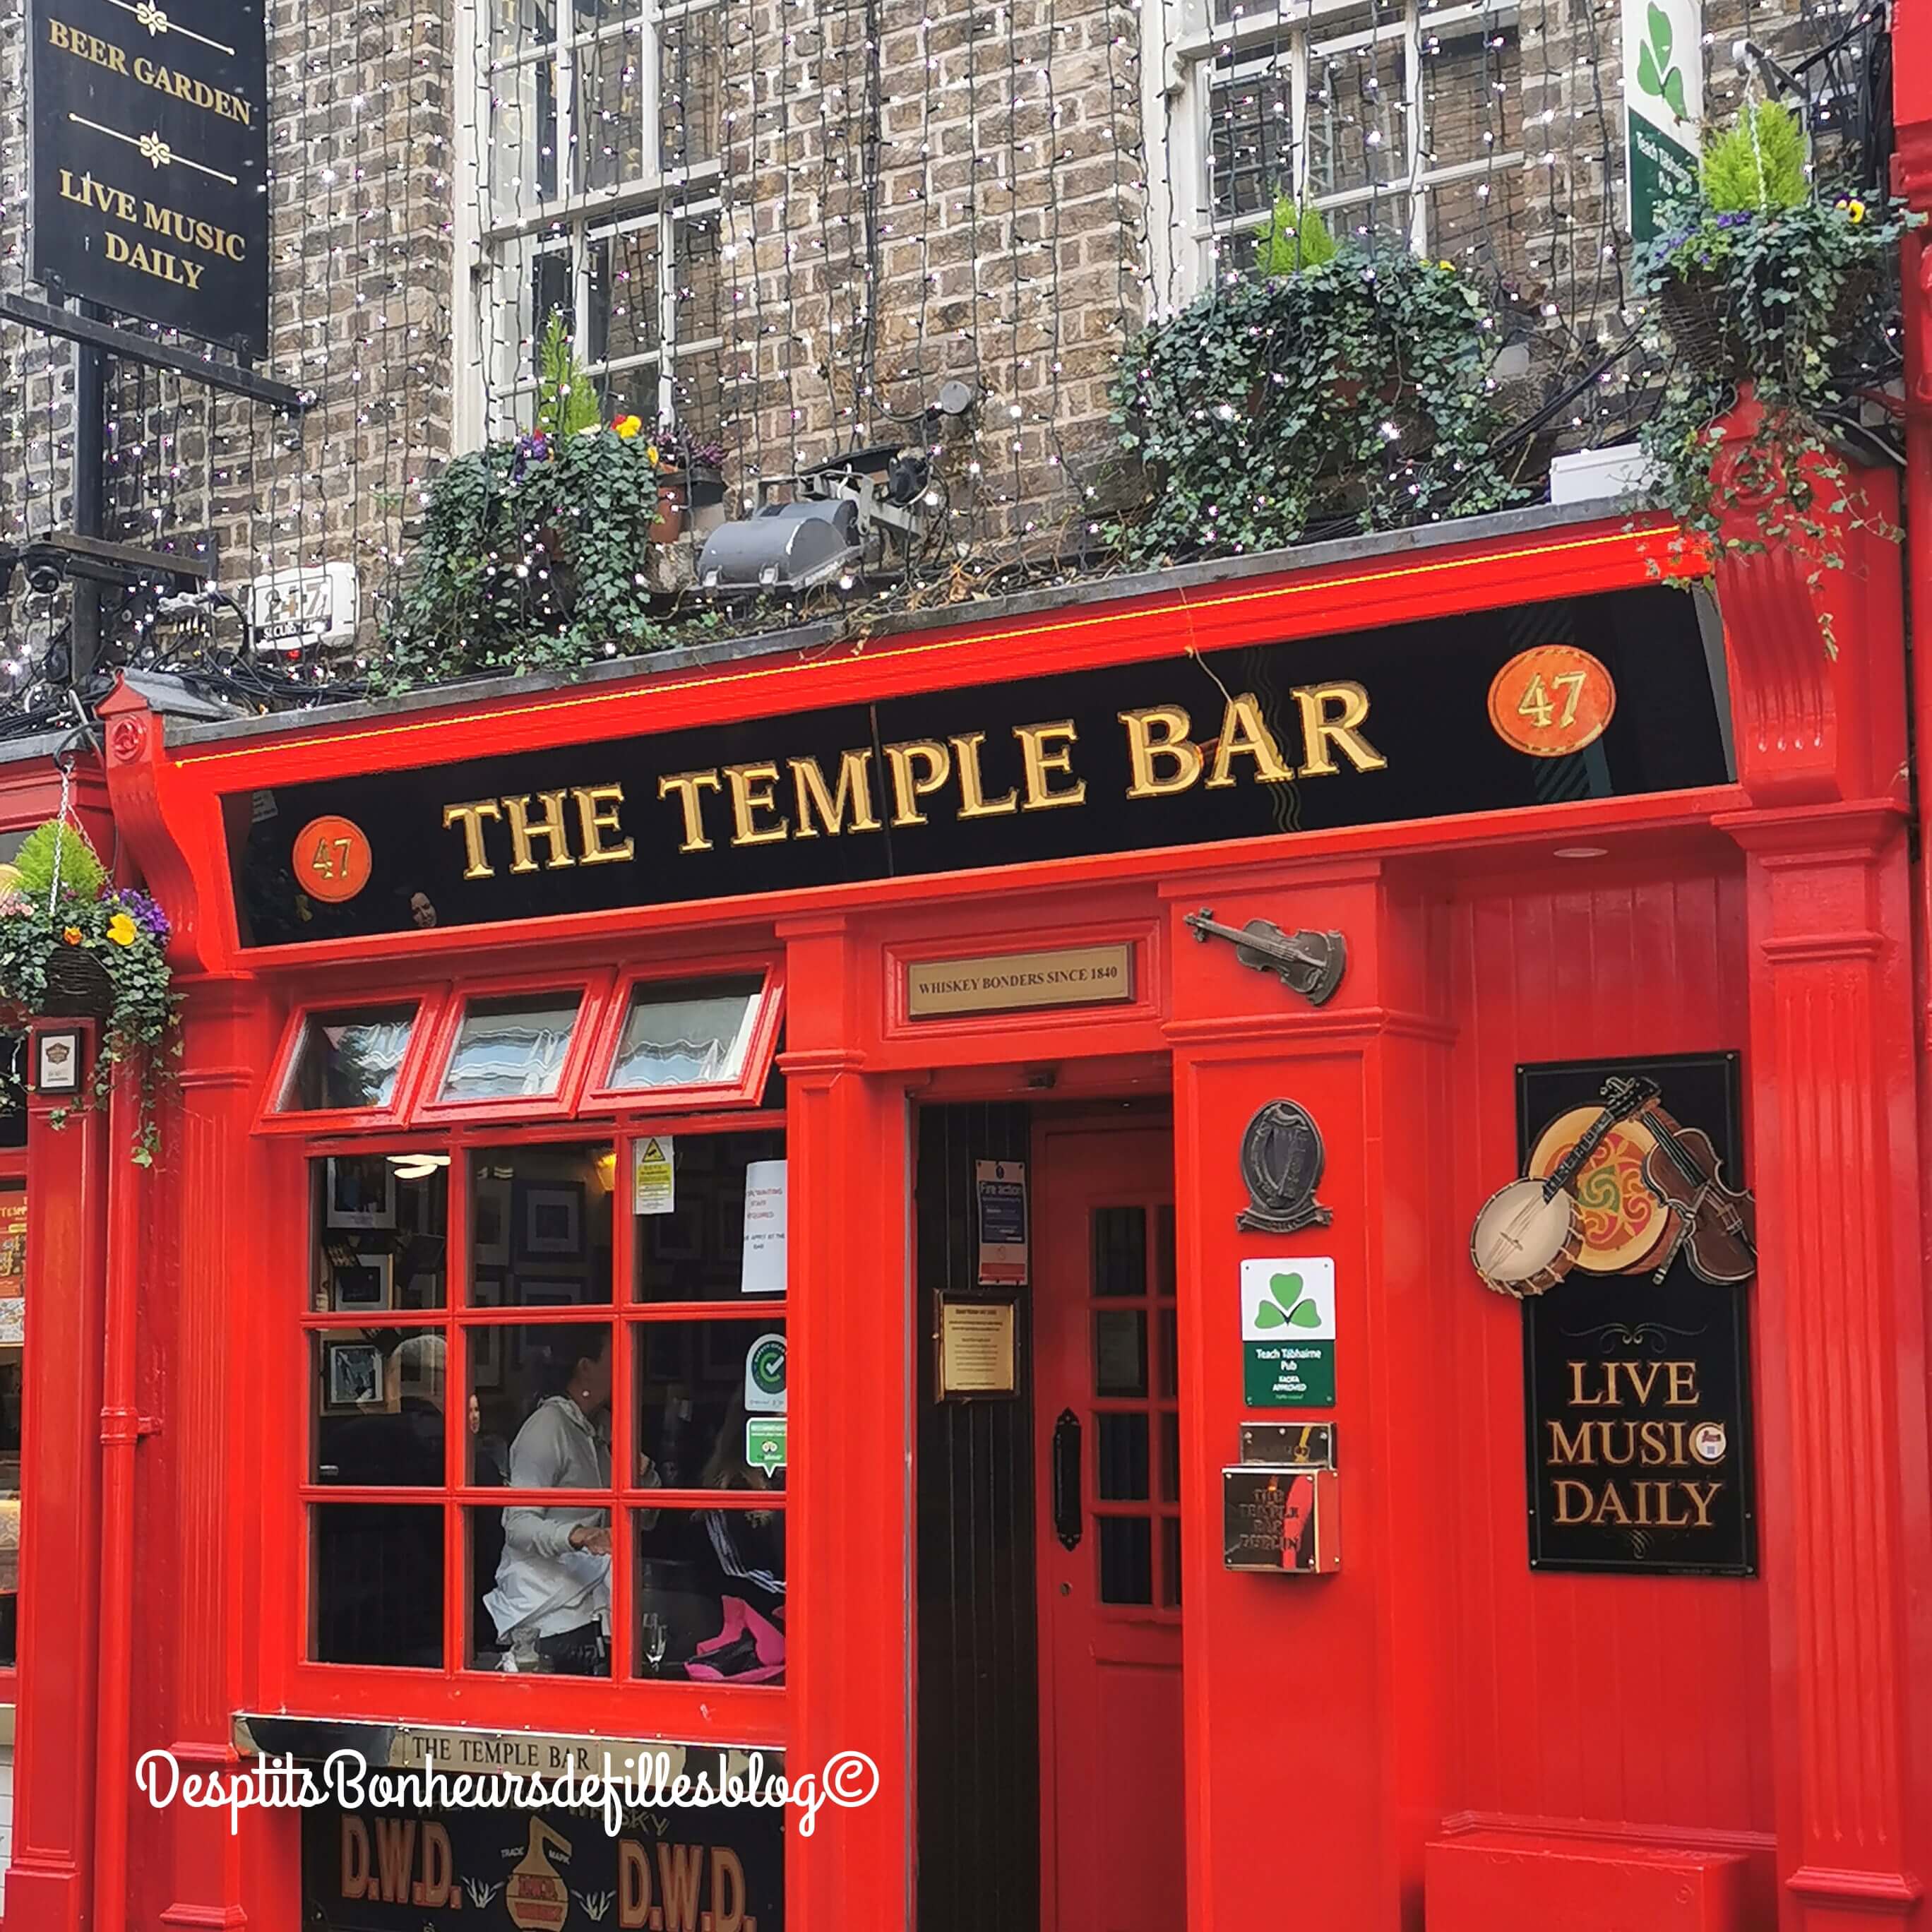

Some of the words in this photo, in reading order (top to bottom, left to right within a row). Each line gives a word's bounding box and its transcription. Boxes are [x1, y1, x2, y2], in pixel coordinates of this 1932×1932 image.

[49, 18, 130, 76] BEER
[133, 57, 252, 125] GARDEN
[59, 169, 137, 222] LIVE
[143, 201, 246, 261] MUSIC
[105, 232, 205, 290] DAILY
[1518, 671, 1587, 729] 47
[442, 782, 635, 880] THE
[657, 719, 1087, 854] TEMPLE
[1117, 679, 1389, 799] BAR
[312, 838, 352, 879] 47
[919, 978, 981, 994] WHISKEY
[983, 972, 1044, 989] BONDERS
[1046, 968, 1087, 984] SINCE
[1090, 966, 1117, 979] 1840
[1256, 1348, 1280, 1359] Teach
[1281, 1361, 1297, 1371] Pub
[1568, 1361, 1700, 1405] LIVE
[1546, 1421, 1727, 1465] MUSIC
[1552, 1480, 1724, 1526] DAILY
[412, 1736, 451, 1760] THE
[459, 1739, 539, 1767] TEMPLE
[549, 1745, 590, 1770] BAR
[341, 1813, 462, 1909] D.W.D.
[619, 1839, 758, 1932] D.W.D.
